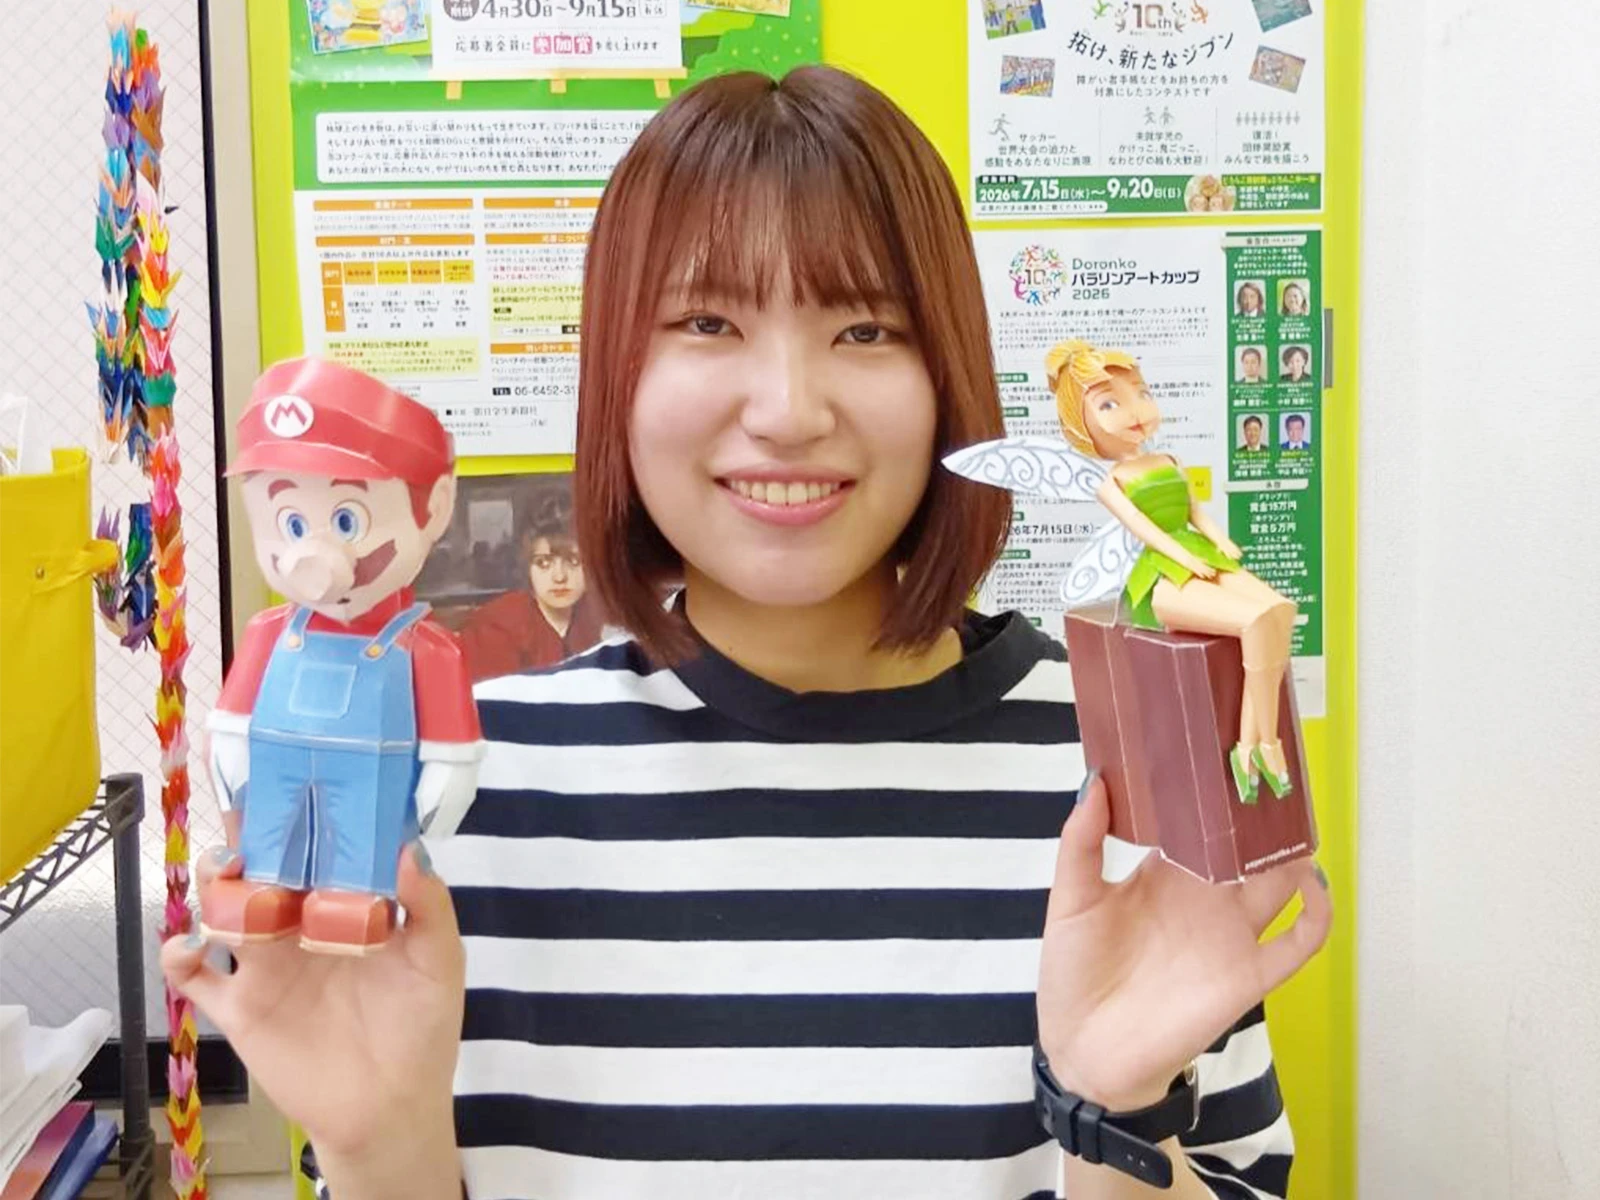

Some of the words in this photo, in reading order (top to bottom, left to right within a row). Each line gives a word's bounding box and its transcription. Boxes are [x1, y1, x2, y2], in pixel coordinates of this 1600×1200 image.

[1132, 3, 1173, 29] 10th
[1067, 31, 1234, 70] 拓け、新たなジブン
[1020, 134, 1057, 142] サッカー
[1071, 257, 1137, 271] Doronko
[1071, 270, 1201, 287] パラリンアートカップ
[1072, 289, 1110, 300] 2026
